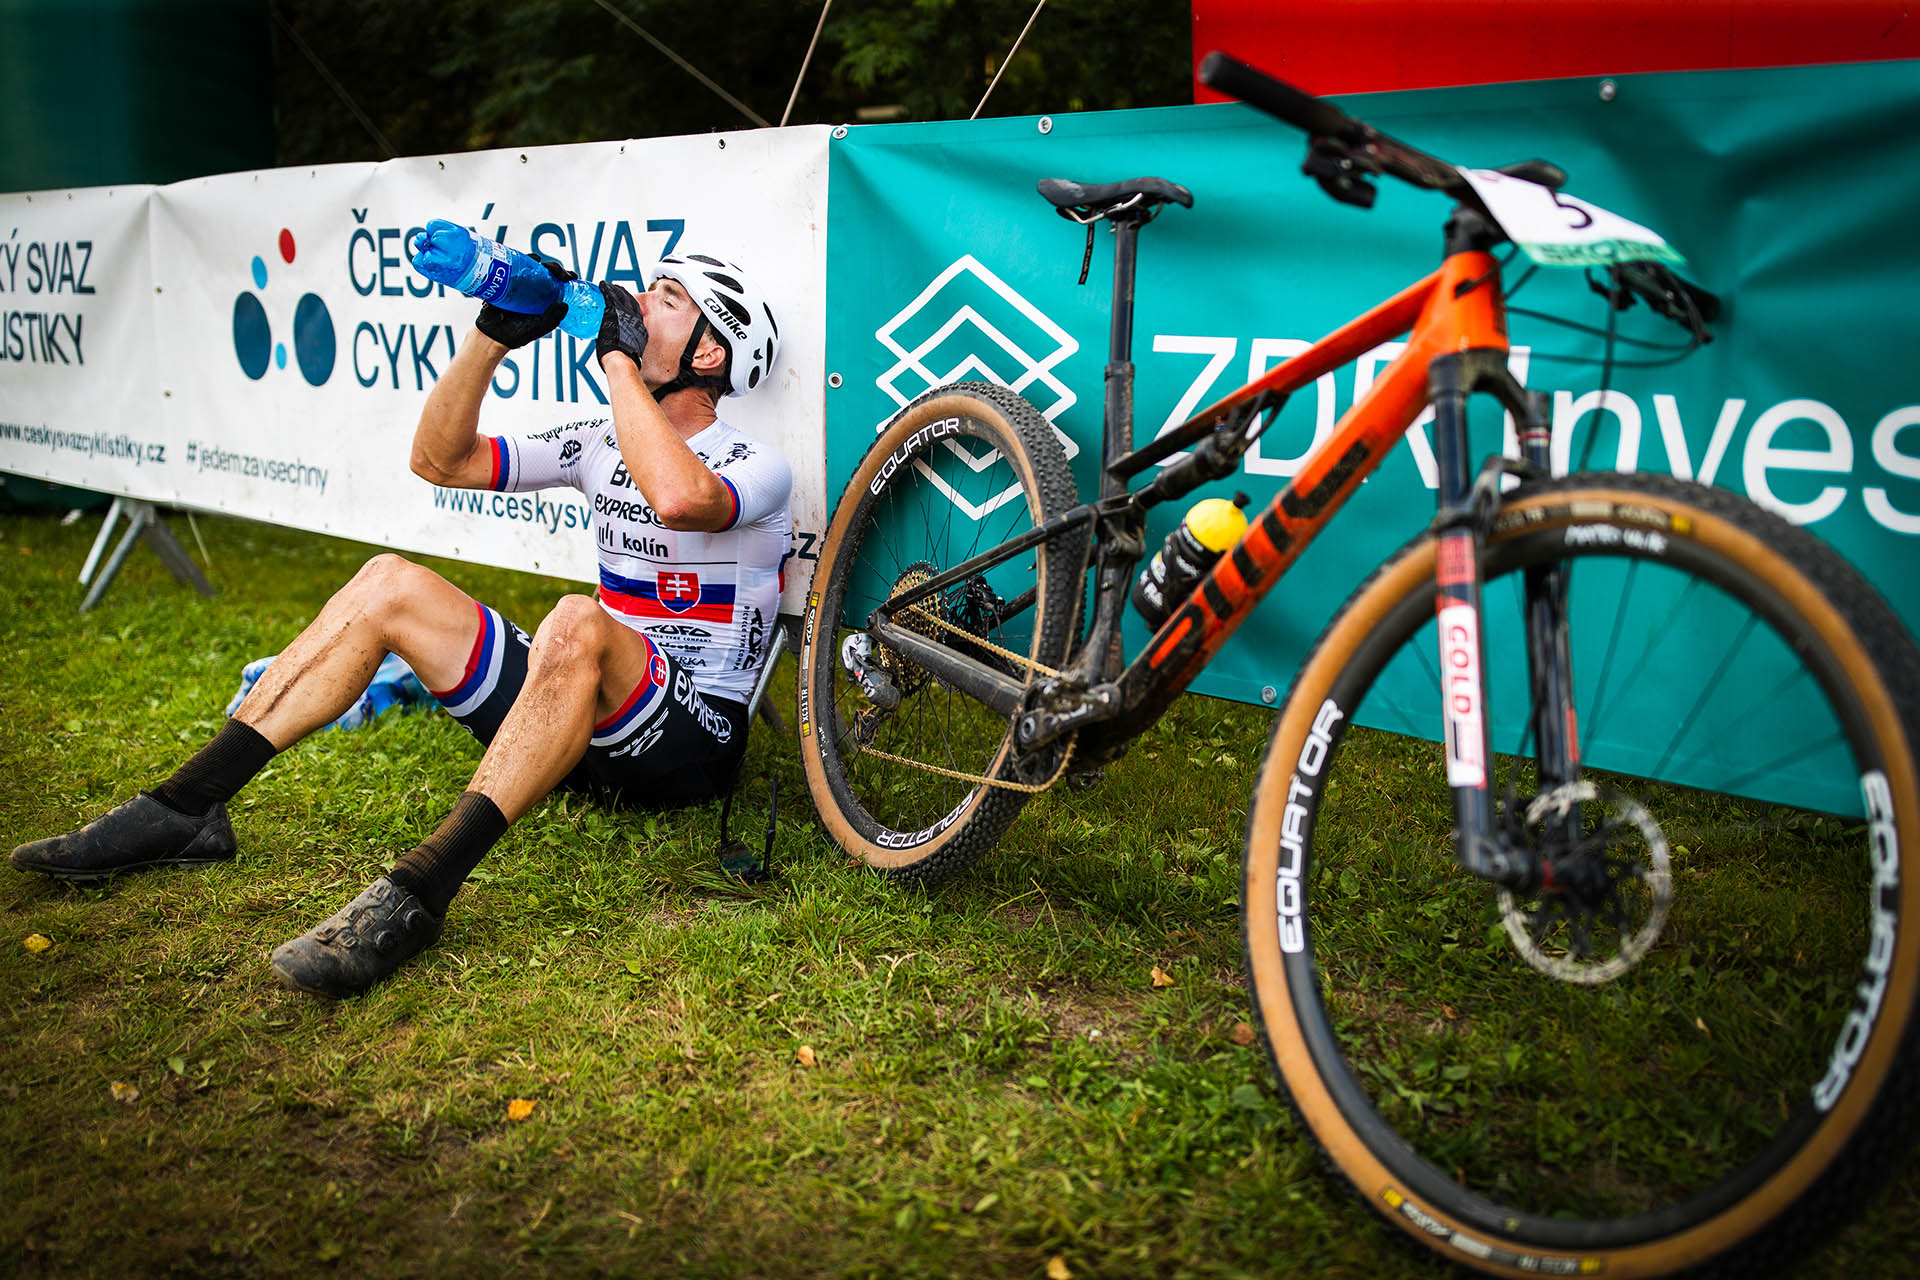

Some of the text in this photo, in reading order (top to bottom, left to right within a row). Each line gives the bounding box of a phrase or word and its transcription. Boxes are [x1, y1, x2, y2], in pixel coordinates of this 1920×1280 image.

[26, 241, 96, 294] SVAZ
[0, 309, 84, 366] ISTIKY
[703, 297, 748, 341] catlike
[870, 417, 960, 496] EQUATOR
[622, 531, 669, 558] kolín
[643, 624, 712, 637] TUFO
[804, 608, 817, 643] TUFO
[1446, 624, 1472, 715] GOLD
[876, 789, 974, 848] EQUATOR
[1276, 698, 1344, 954] EQUATOR
[1812, 770, 1900, 1114] EQUATOR
